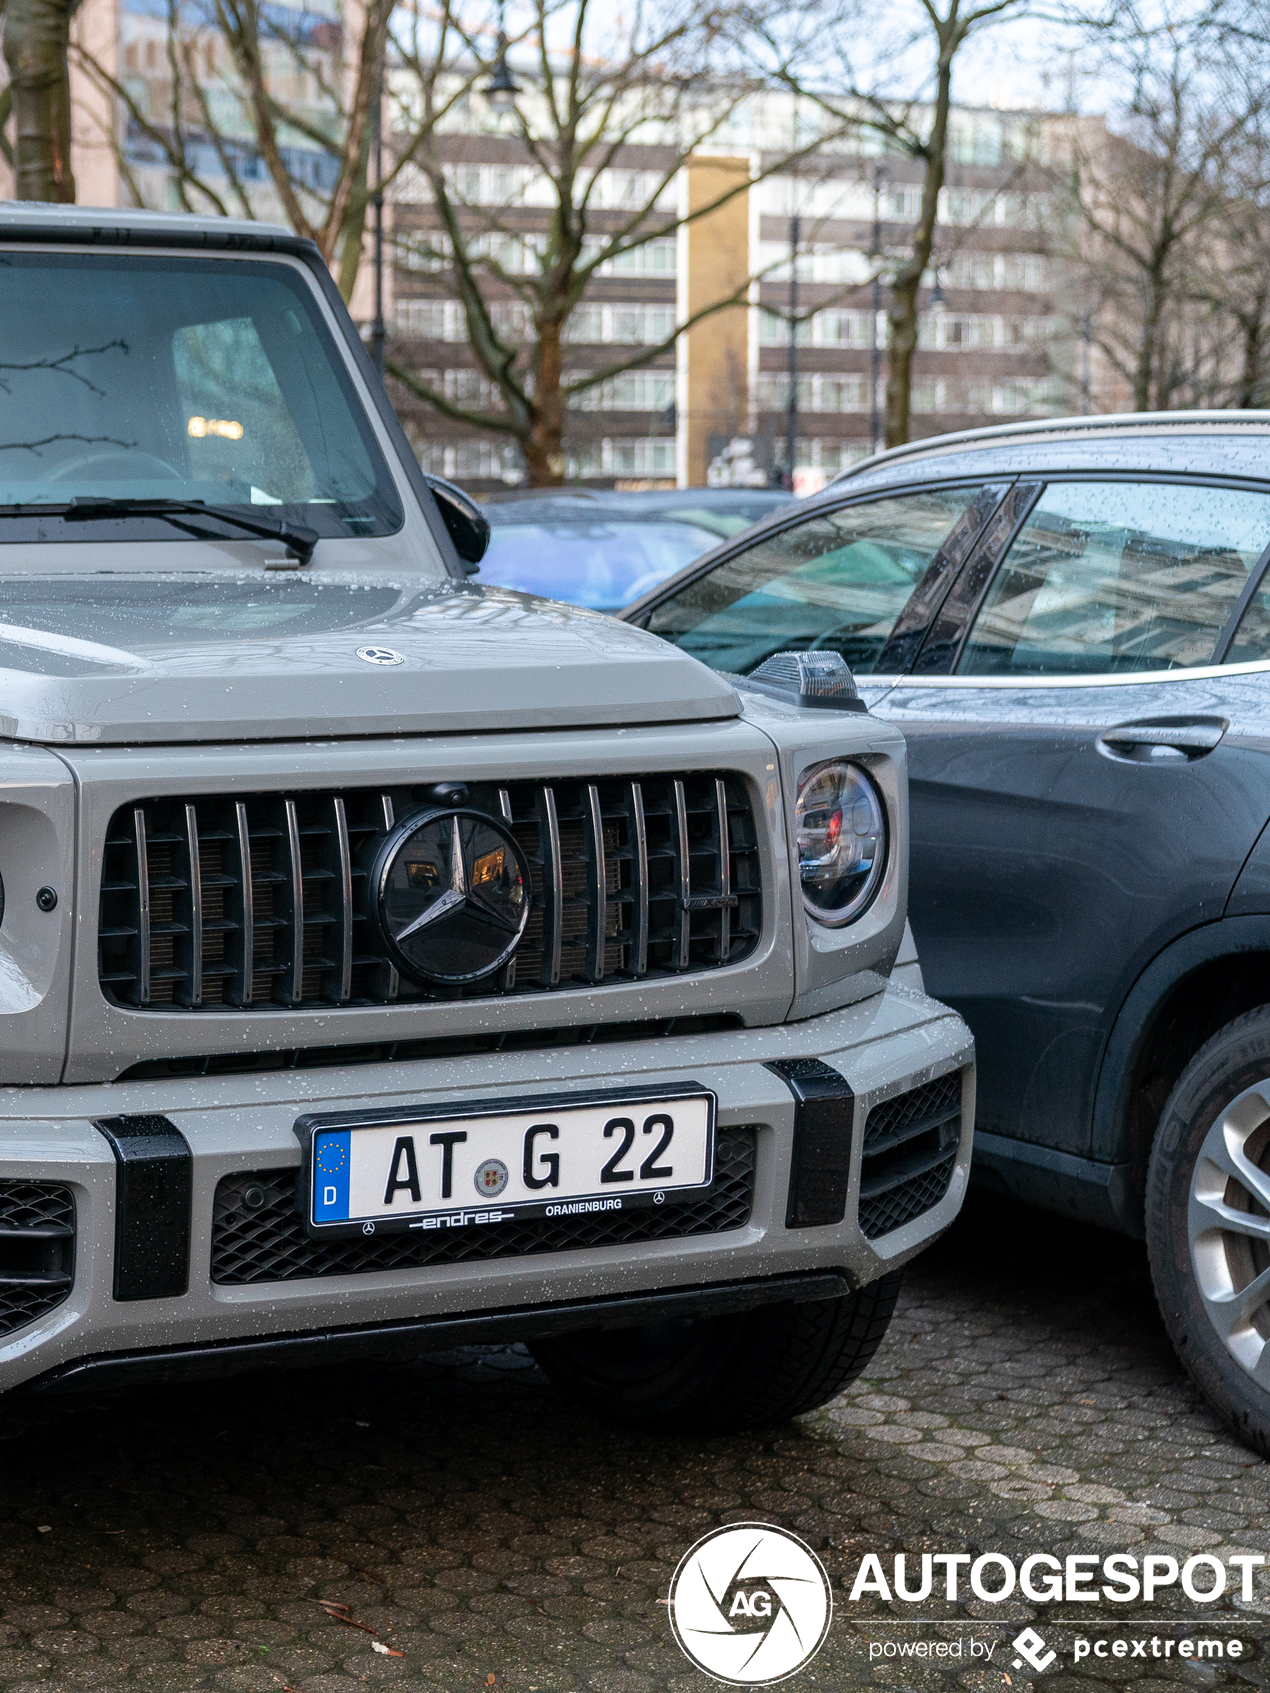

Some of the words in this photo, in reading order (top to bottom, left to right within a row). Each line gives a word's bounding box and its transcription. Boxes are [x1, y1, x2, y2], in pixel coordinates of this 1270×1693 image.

[383, 1131, 468, 1205] AT
[522, 1123, 560, 1190] G
[600, 1113, 674, 1184] 22
[323, 1186, 337, 1206] D
[545, 1199, 622, 1217] ORANIENBURG
[420, 1210, 503, 1230] endres
